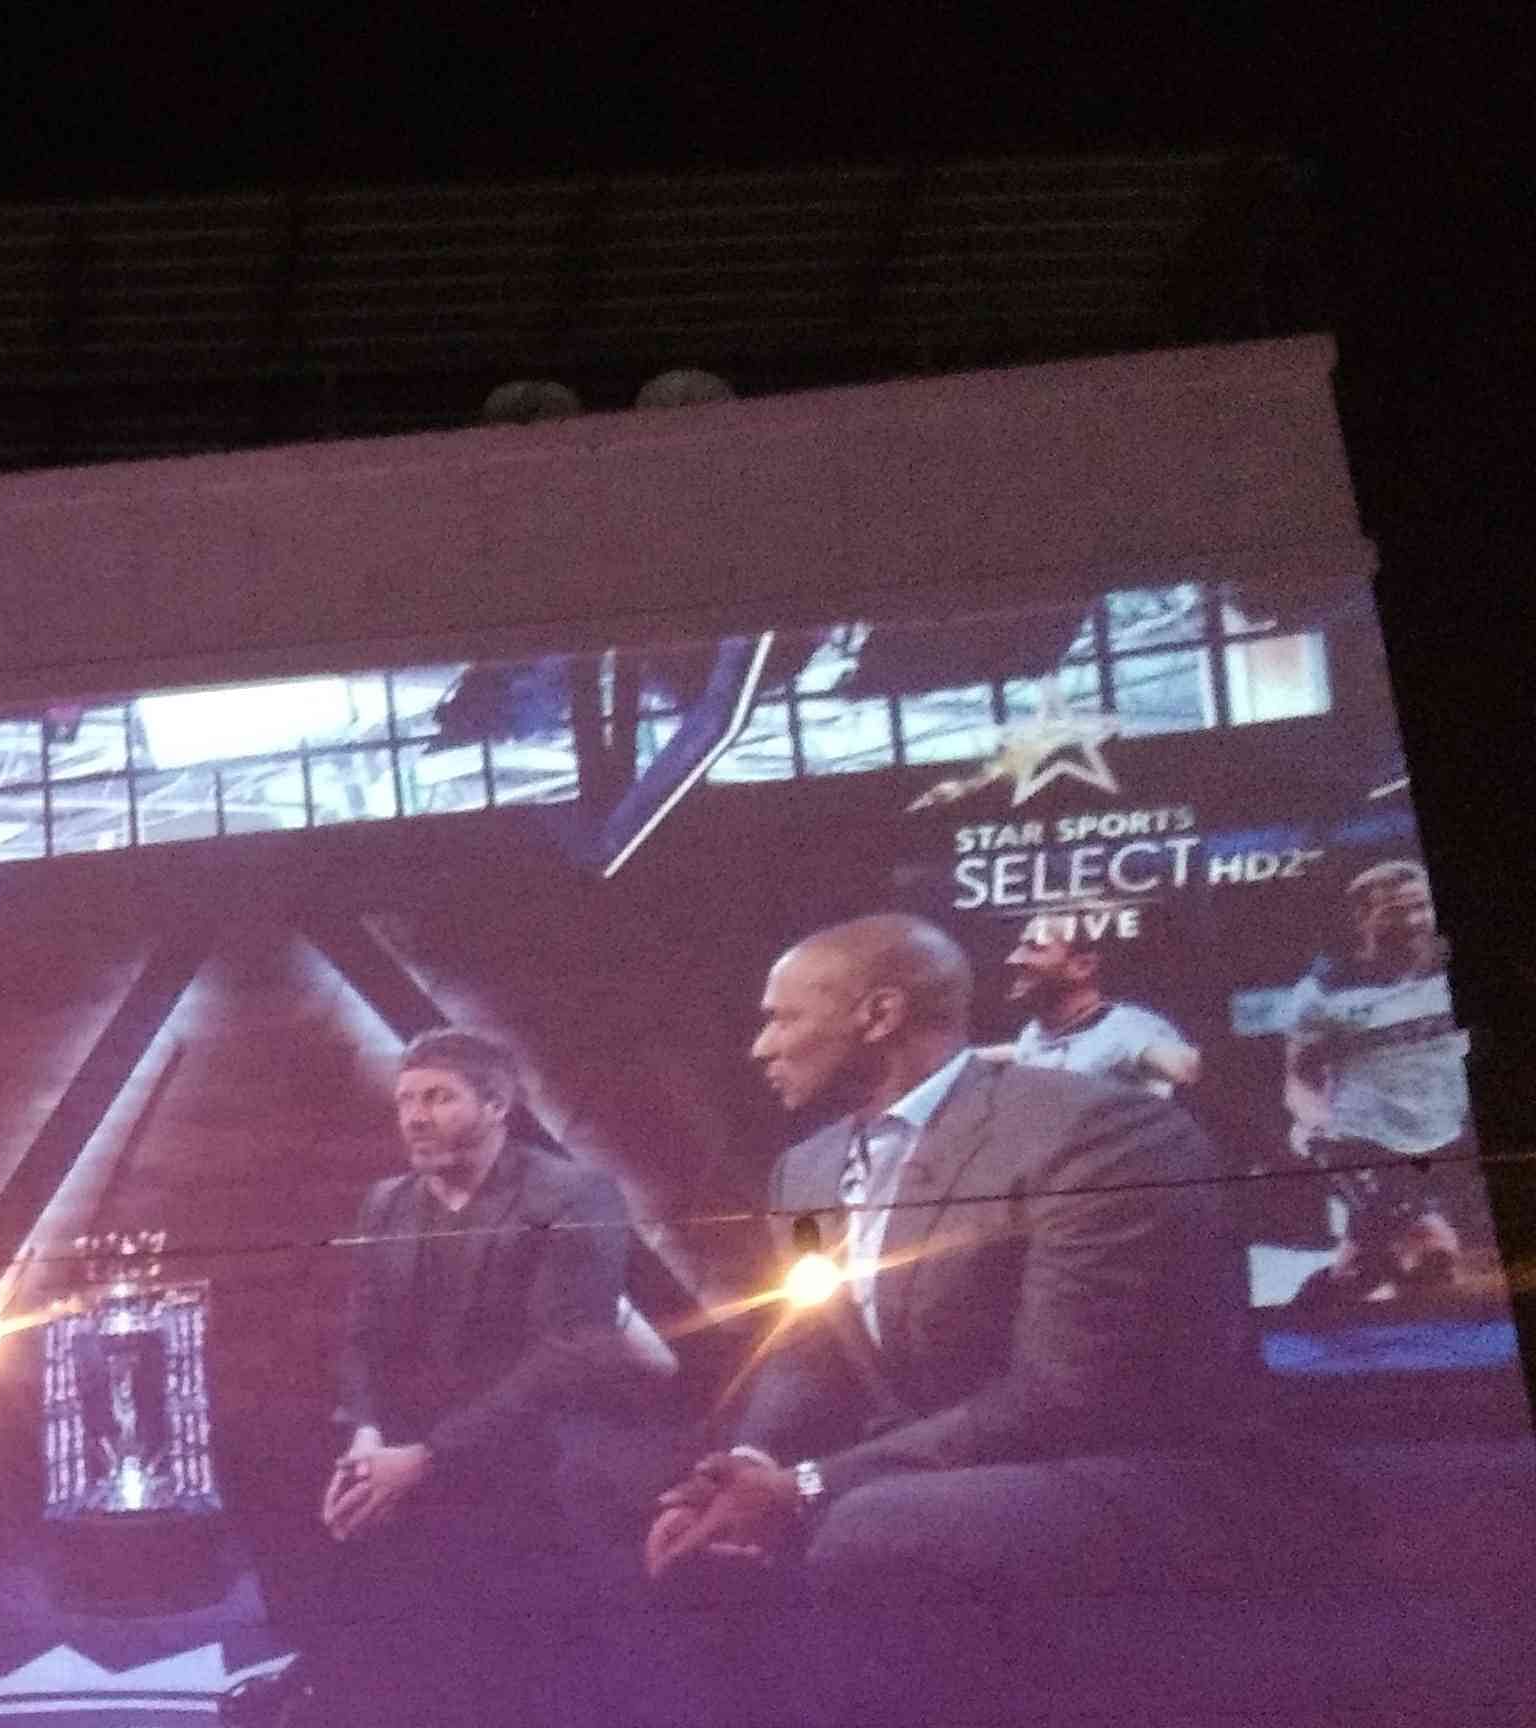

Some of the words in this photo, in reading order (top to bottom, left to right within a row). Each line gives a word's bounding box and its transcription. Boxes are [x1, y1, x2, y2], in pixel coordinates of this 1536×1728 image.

[954, 824, 1042, 853] STAR
[1057, 807, 1194, 840] SPORTS
[954, 838, 1199, 909] SELECT
